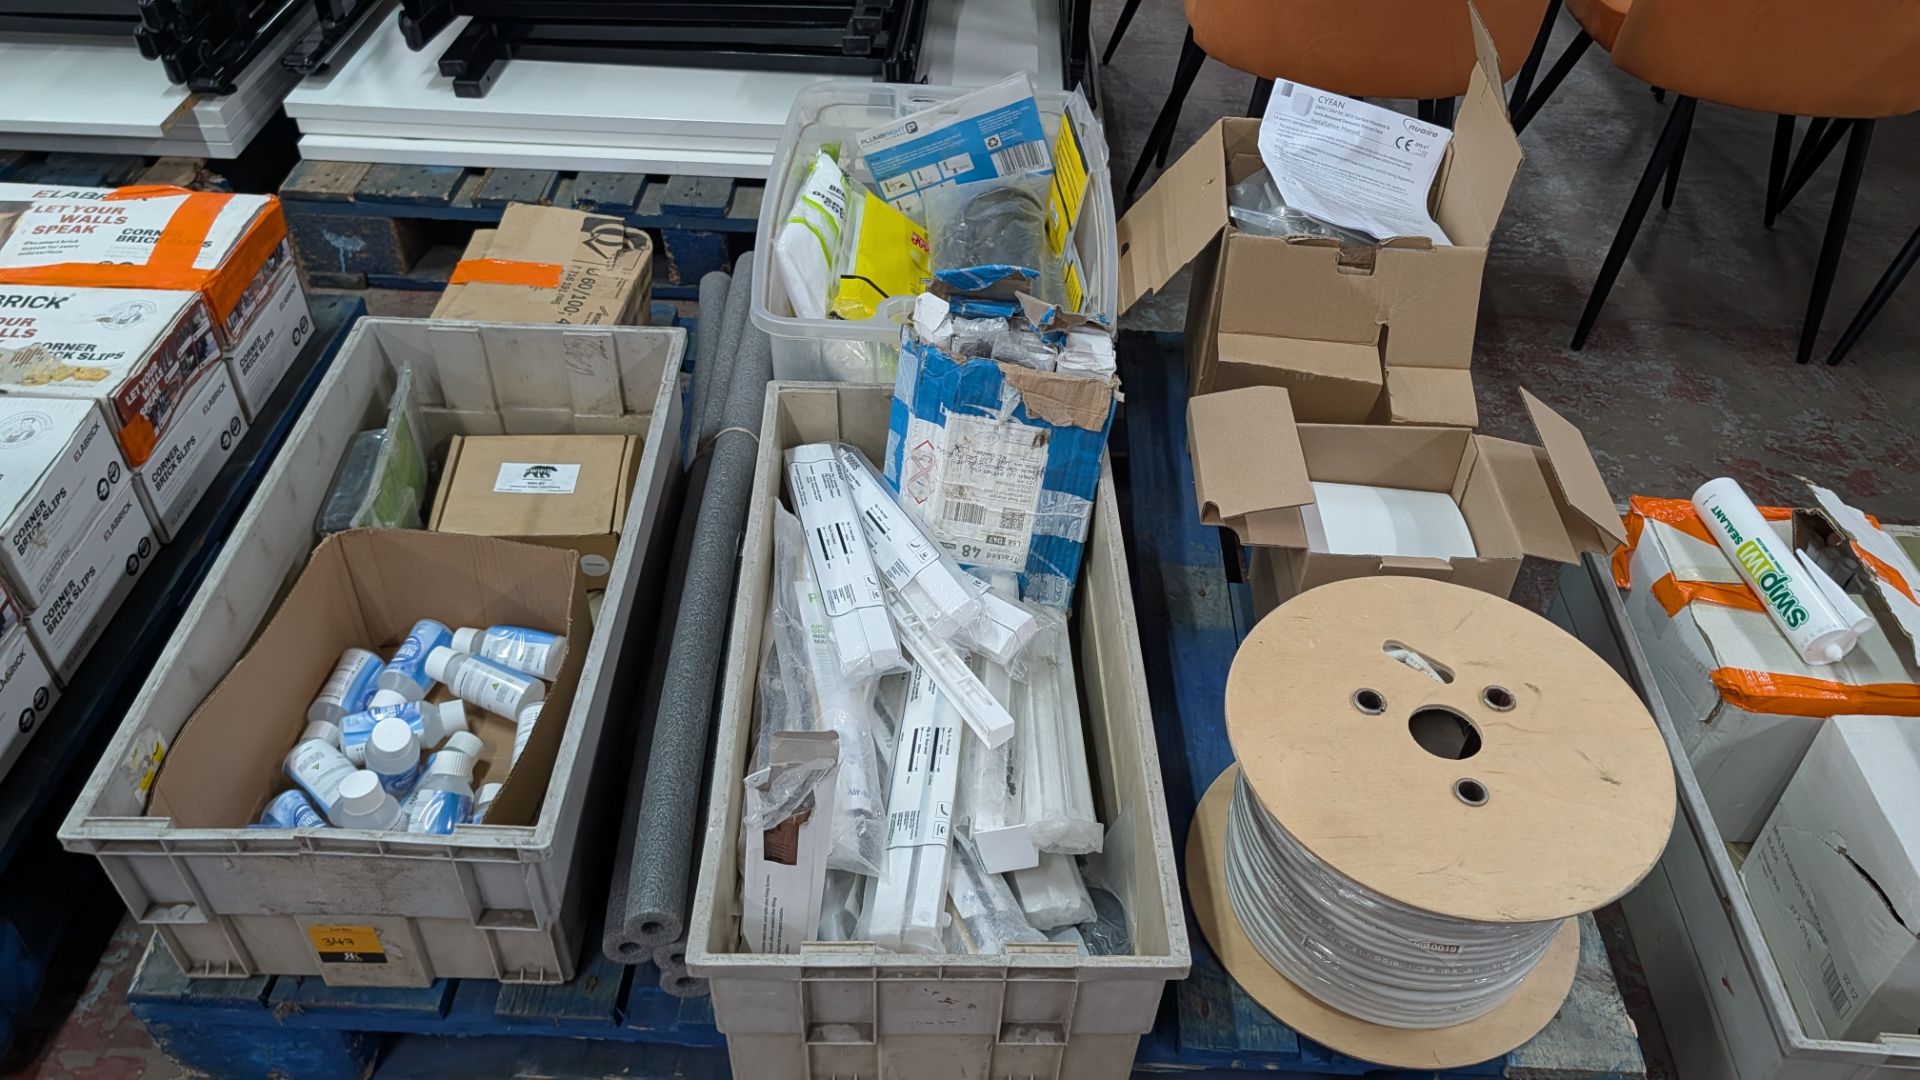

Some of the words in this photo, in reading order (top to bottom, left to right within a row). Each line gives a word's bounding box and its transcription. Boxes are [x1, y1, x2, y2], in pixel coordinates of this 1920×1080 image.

[1317, 95, 1346, 109] CYFAN
[1310, 117, 1341, 131] Installation
[1340, 125, 1361, 136] Manual
[1408, 124, 1439, 138] nuaire
[33, 205, 70, 214] LET
[73, 206, 126, 215] YOUR
[60, 215, 129, 224] WALLS
[32, 225, 100, 235] SPEAK
[115, 235, 162, 244] BRIC
[121, 228, 163, 236] CORN
[33, 342, 97, 352] ORNER
[76, 351, 125, 360] SLIPS
[240, 335, 261, 368] CORNER
[242, 351, 261, 376] BRICK
[259, 329, 275, 353] SLIPS
[125, 384, 141, 406] LET
[139, 361, 158, 388] YOUR
[142, 367, 163, 400] WALLS
[140, 385, 161, 420] SPEAK
[73, 420, 101, 463] ELABRICK
[152, 444, 180, 483] CORNER
[155, 462, 179, 492] BRICK
[177, 435, 196, 466] SLIPS
[42, 487, 67, 521] SLIPS
[12, 499, 47, 546] CORNER
[103, 501, 132, 542] ELABRICK
[1710, 504, 1744, 546] SEALANT
[961, 544, 982, 559] 48
[986, 551, 1021, 565] Tracked
[42, 579, 76, 626] CORNER
[46, 597, 74, 635] BRICK
[72, 566, 97, 599] SLIPS
